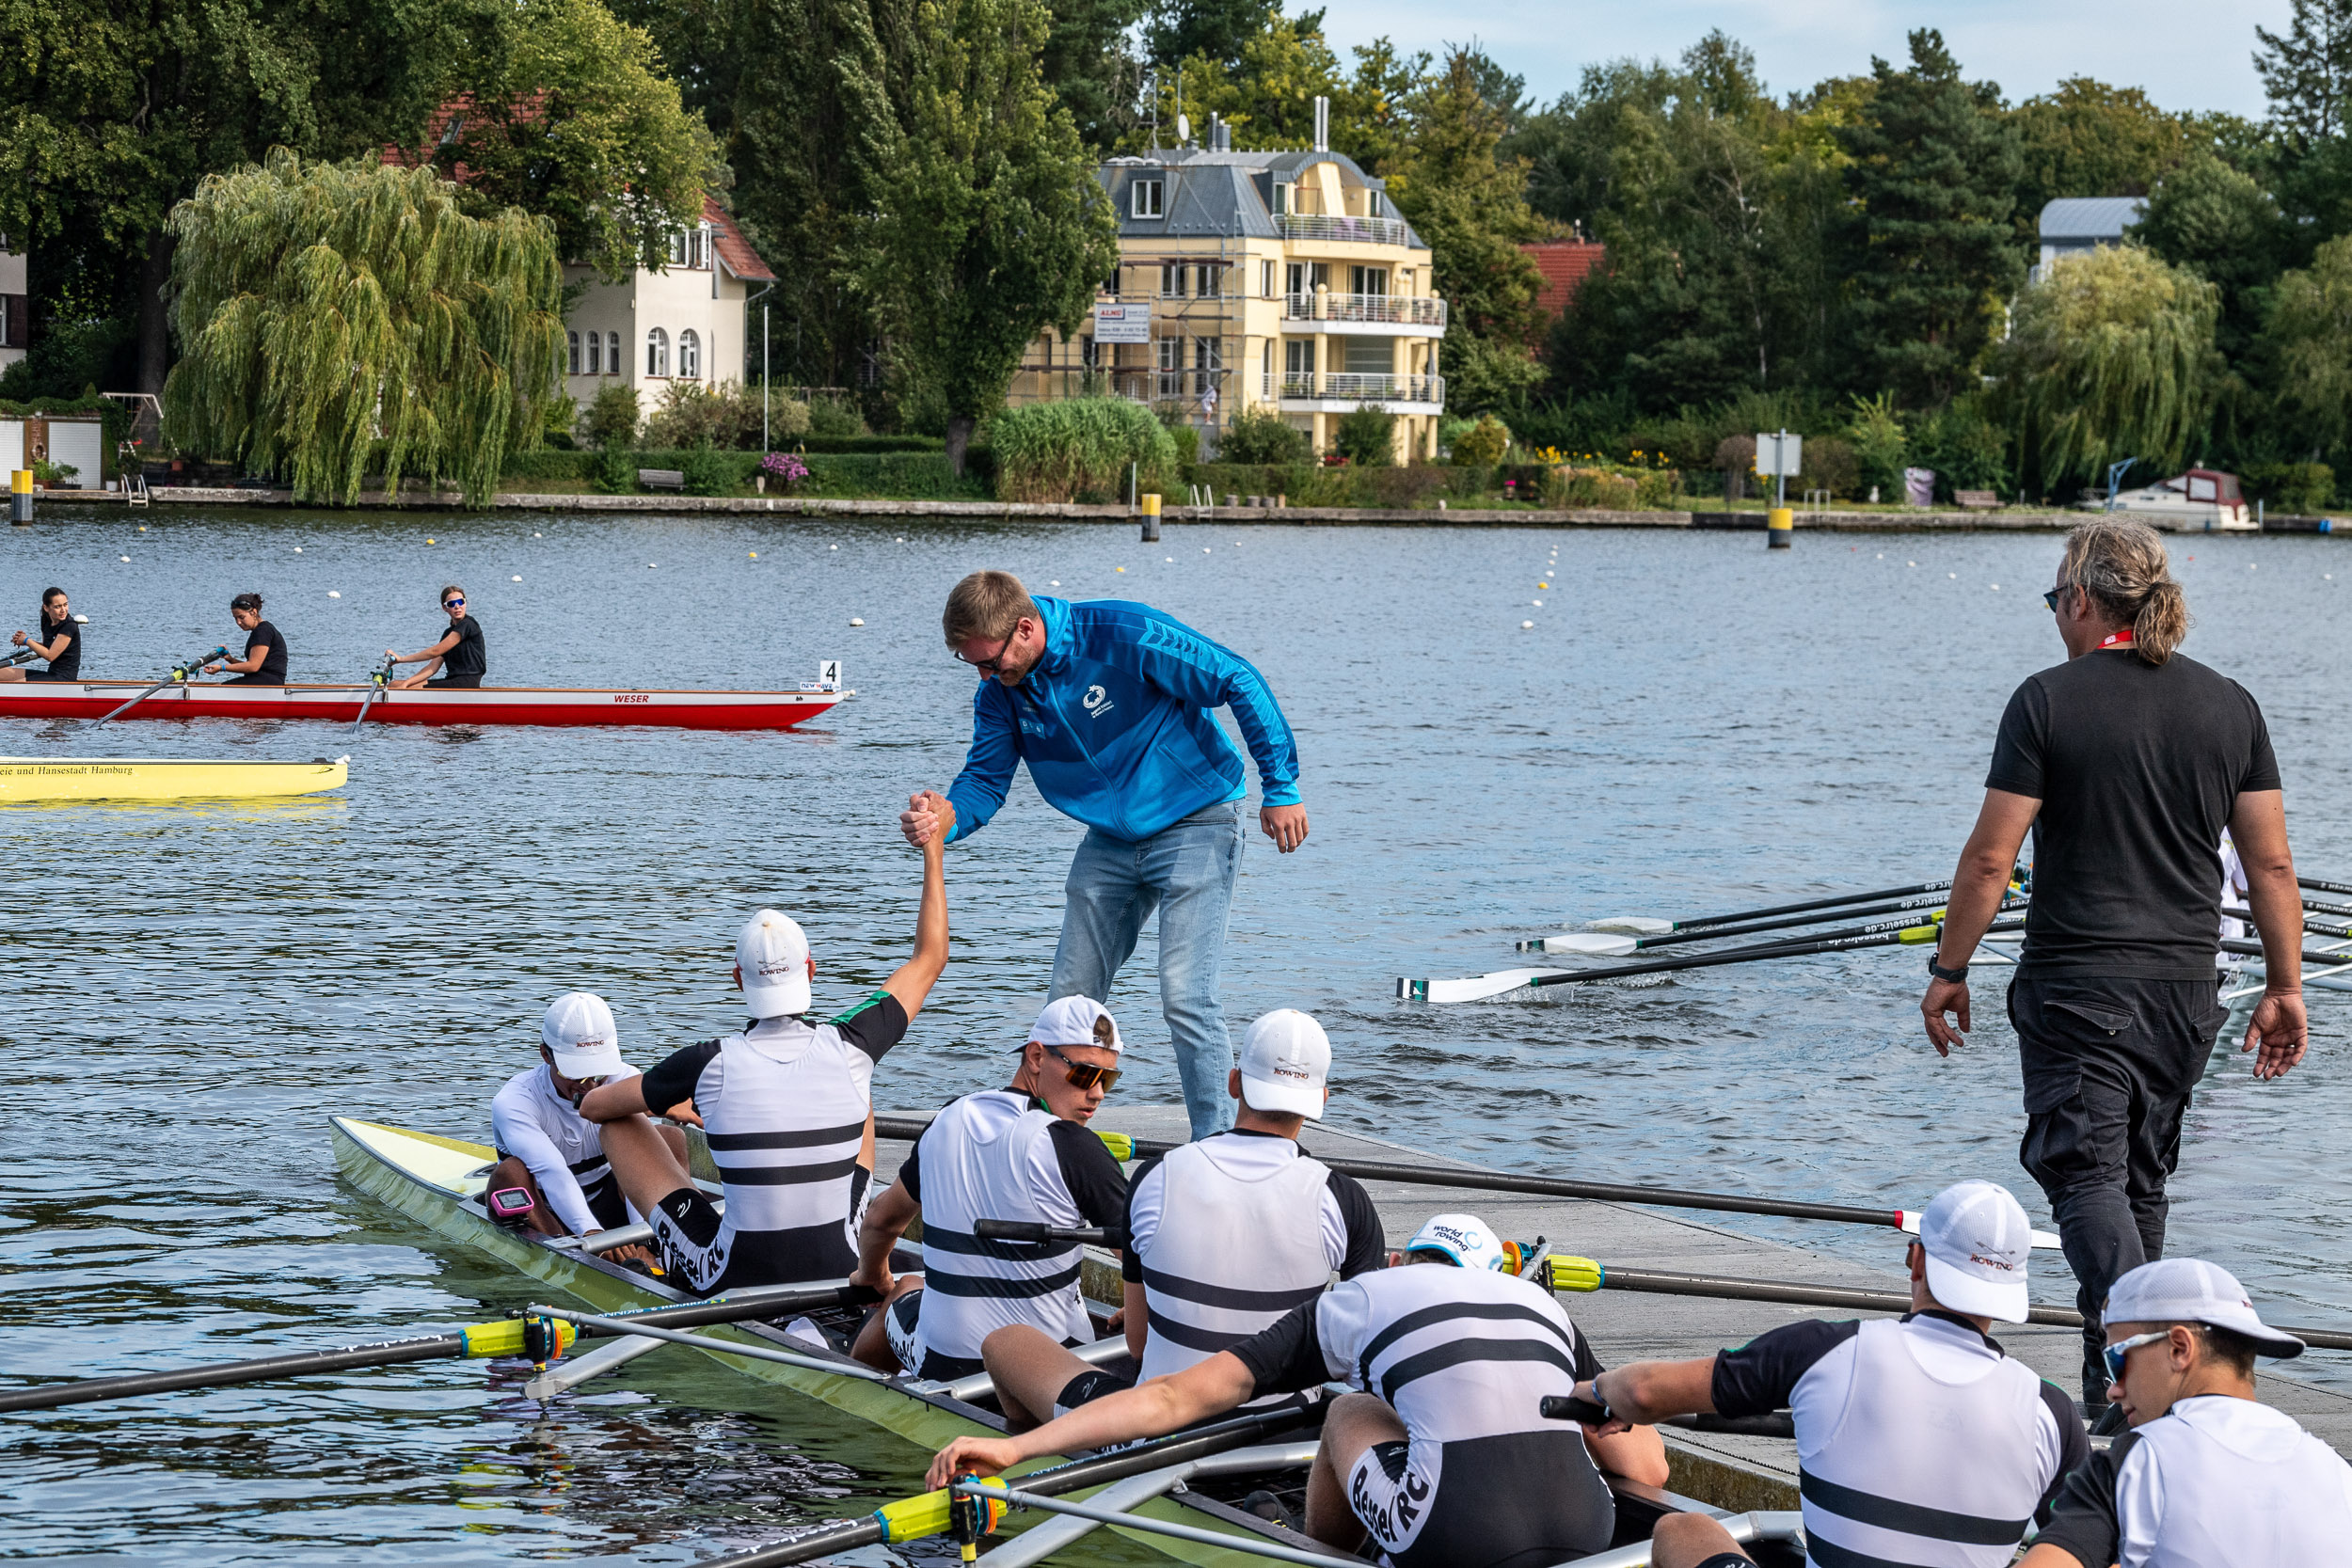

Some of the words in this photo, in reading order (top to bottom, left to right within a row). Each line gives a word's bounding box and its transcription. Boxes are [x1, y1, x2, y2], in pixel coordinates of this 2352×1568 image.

[826, 661, 836, 682] 4
[17, 767, 34, 775] und
[39, 767, 87, 775] Hansestadt
[91, 766, 133, 775] Hamburg
[1900, 895, 1950, 909] esselrc.de
[1865, 916, 1922, 933] besselrc.de
[758, 966, 789, 976] ROWING
[576, 1039, 605, 1048] ROWING
[1274, 1067, 1309, 1080] ROWING
[1433, 1225, 1463, 1238] world
[1435, 1231, 1469, 1252] rowing
[1970, 1252, 2012, 1271] ROWING
[1353, 1465, 1398, 1543] Bessel
[1396, 1471, 1429, 1532] RC
